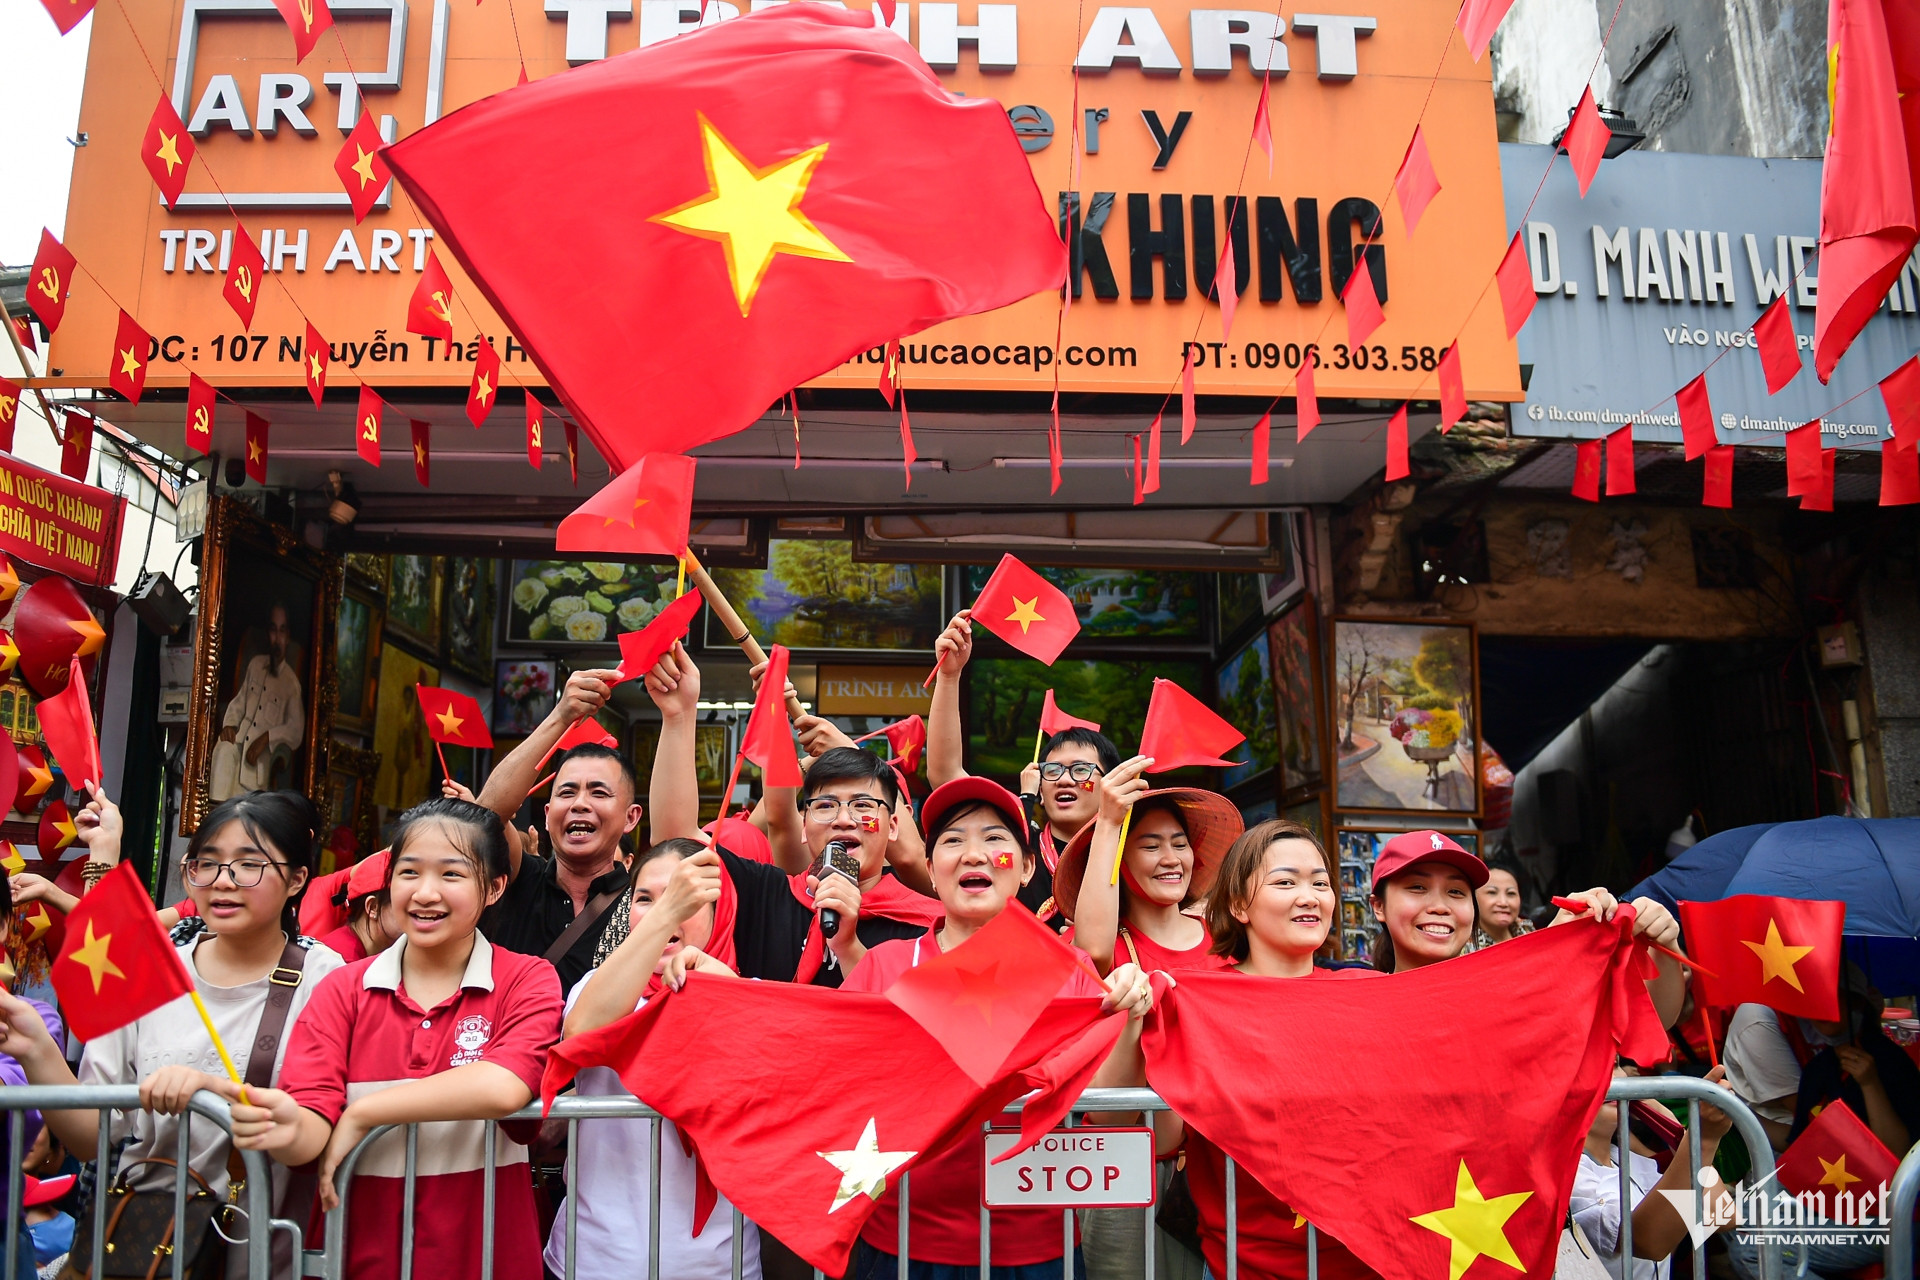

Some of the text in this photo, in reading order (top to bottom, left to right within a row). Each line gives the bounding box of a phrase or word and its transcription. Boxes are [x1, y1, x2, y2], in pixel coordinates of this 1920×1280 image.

[1072, 7, 1377, 80] ART
[186, 73, 372, 136] ART
[323, 229, 435, 273] ART
[1058, 190, 1388, 306] KHUNG
[1526, 221, 1578, 297] D.
[1591, 225, 1736, 304] MANH
[210, 335, 269, 362] 107
[278, 329, 409, 369] Nuyễn
[1663, 322, 1710, 347] VÀO
[16, 474, 54, 513] QUỐC
[56, 491, 103, 533] KHÁNH
[0, 503, 32, 543] GHĨA
[35, 518, 64, 557] VIỆT
[65, 532, 95, 567] NAM
[822, 676, 895, 698] TRÌNH
[1031, 1137, 1105, 1152] POLICE
[1017, 1165, 1120, 1193] STOP
